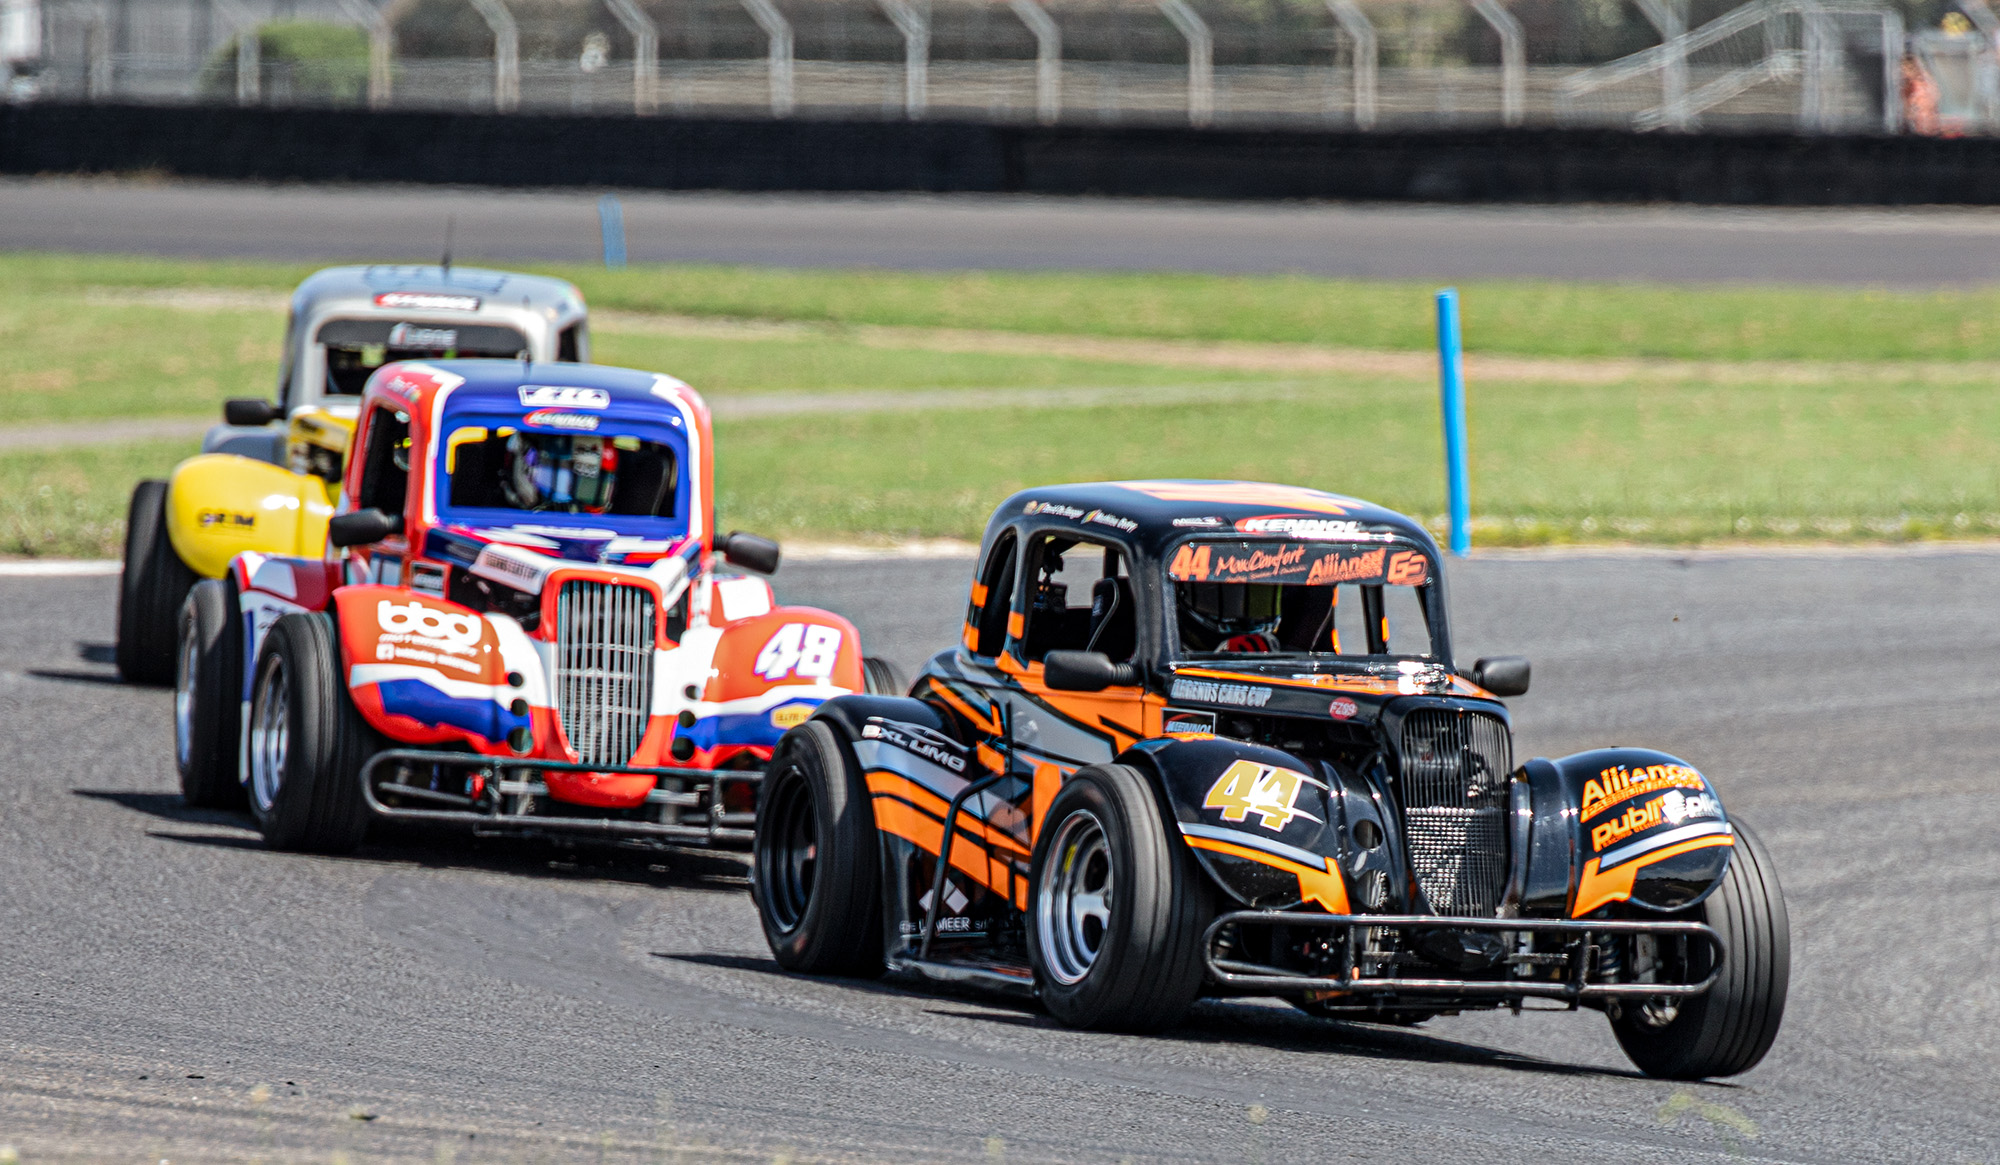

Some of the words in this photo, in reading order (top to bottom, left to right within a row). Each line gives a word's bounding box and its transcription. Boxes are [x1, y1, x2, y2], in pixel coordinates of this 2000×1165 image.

[1169, 545, 1212, 581] 44
[753, 622, 842, 682] 48
[1247, 686, 1273, 707] CUP
[1201, 759, 1301, 833] 44
